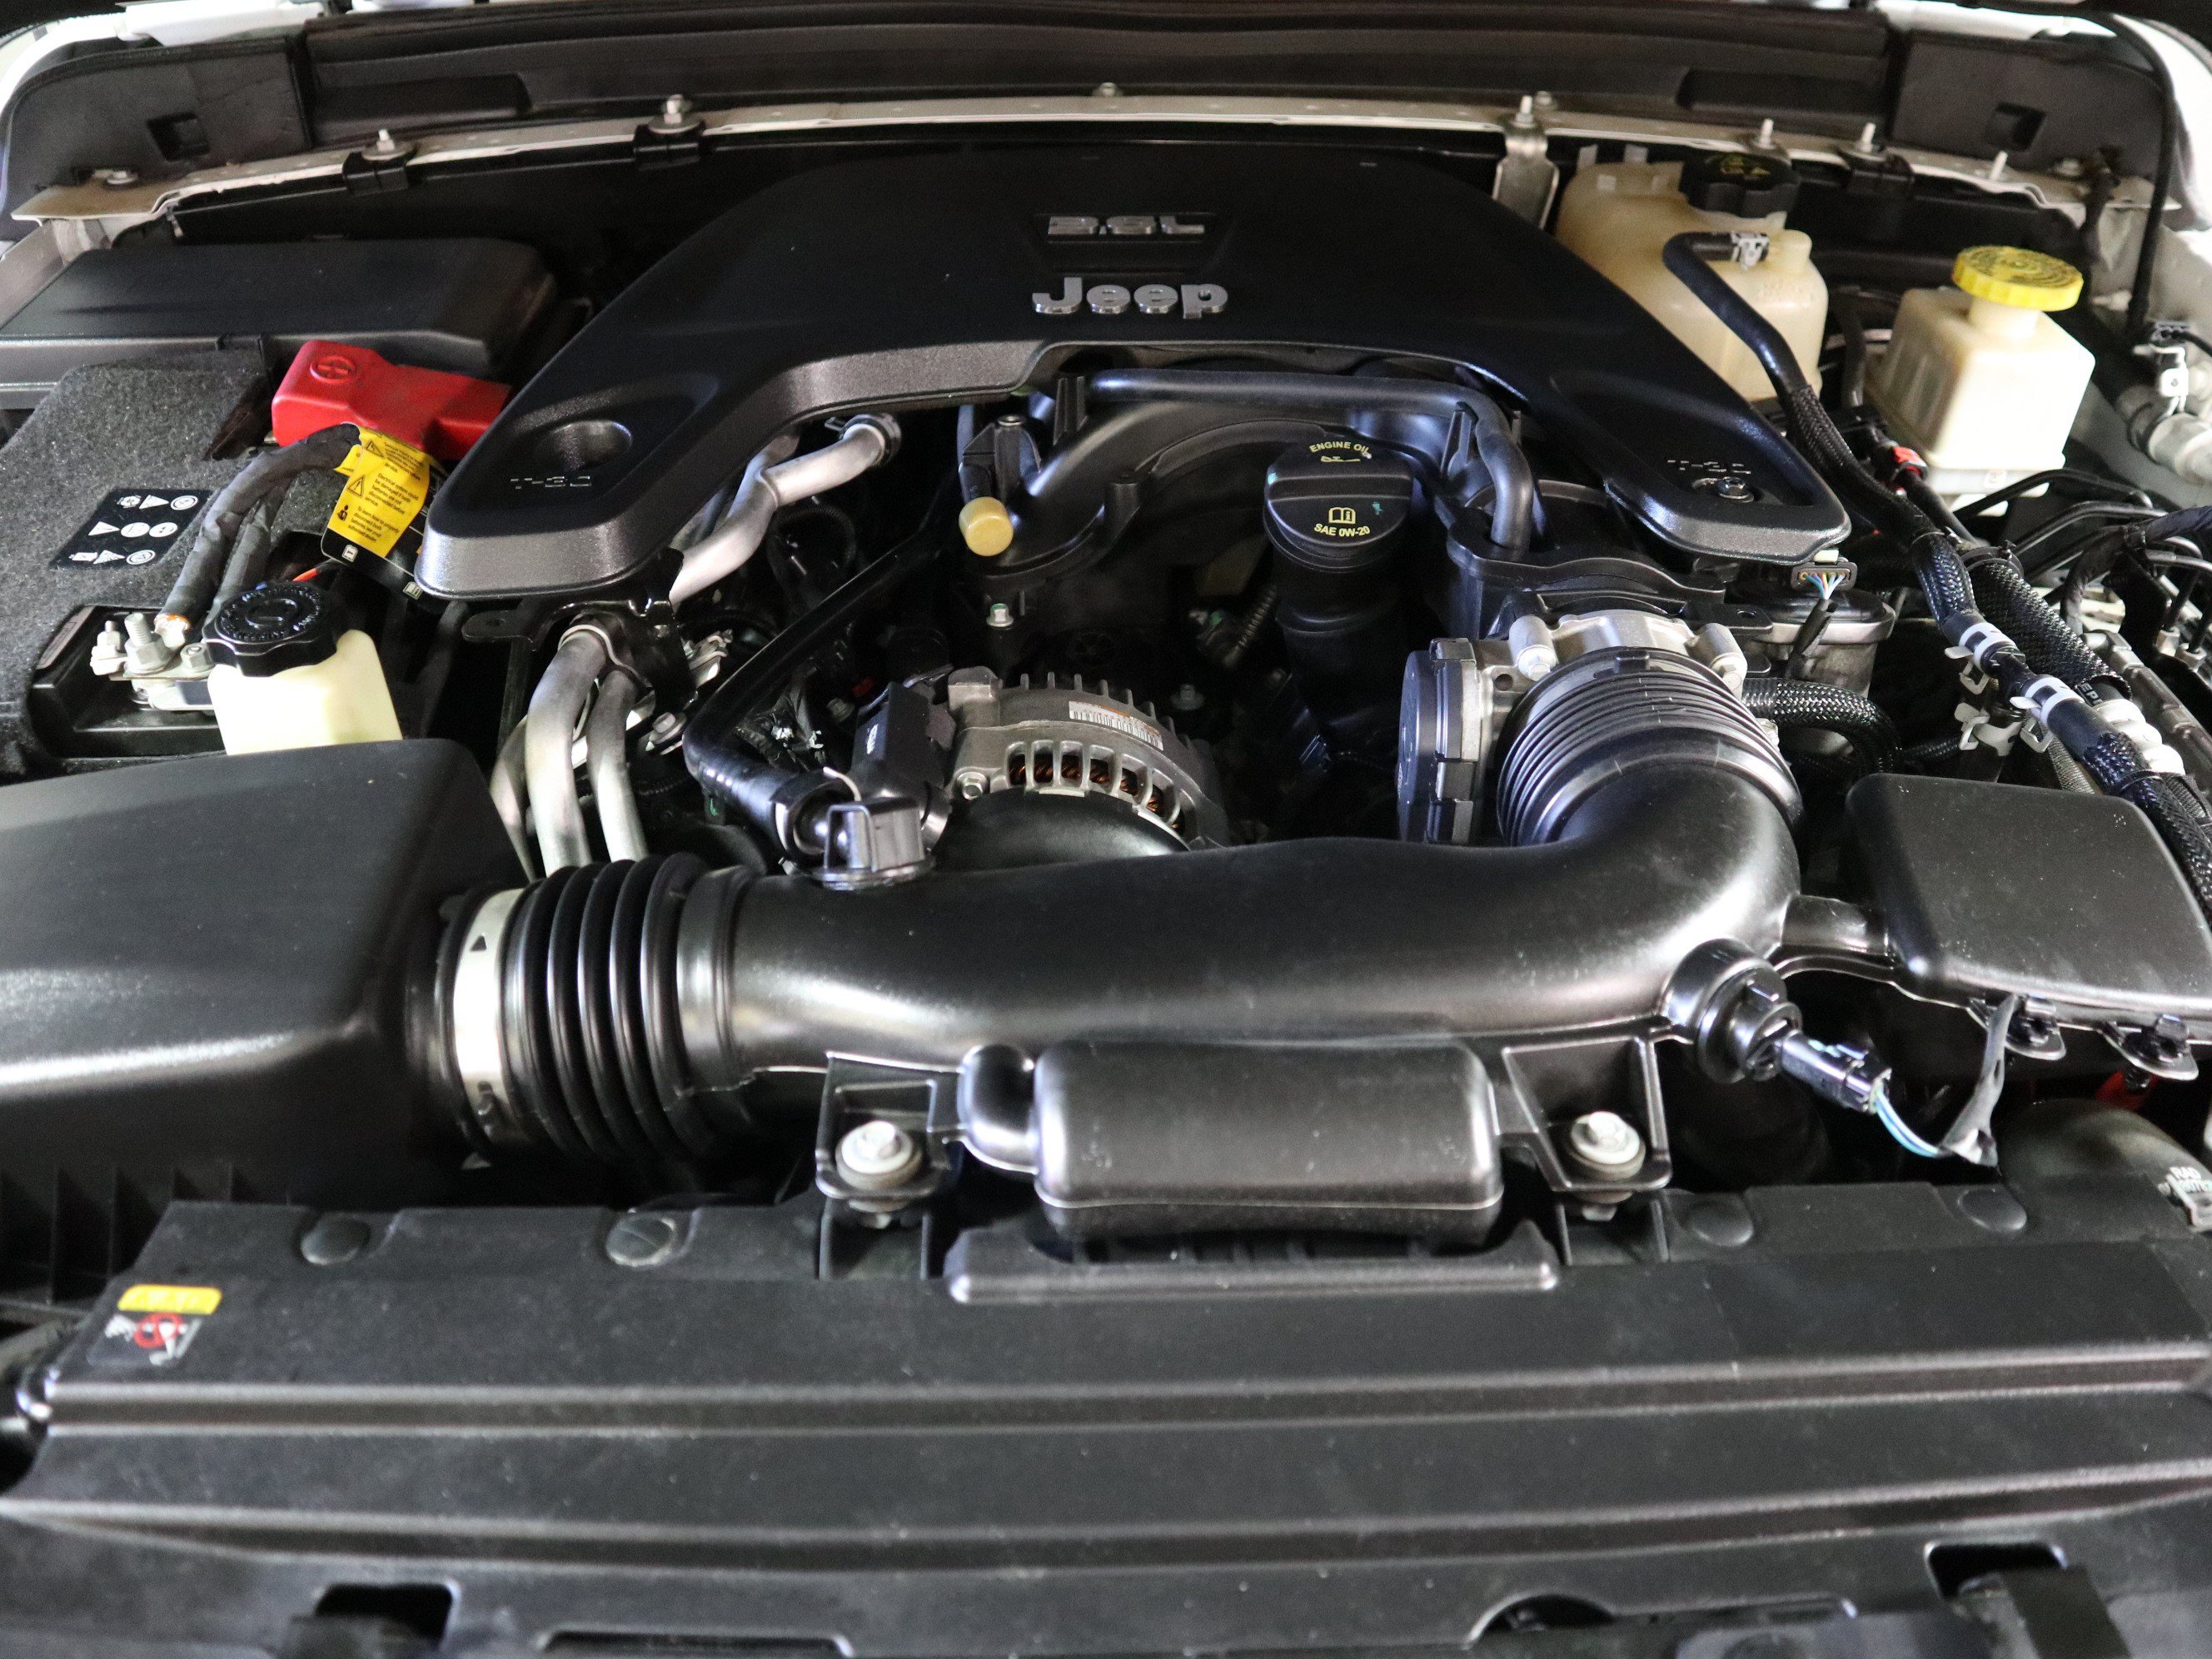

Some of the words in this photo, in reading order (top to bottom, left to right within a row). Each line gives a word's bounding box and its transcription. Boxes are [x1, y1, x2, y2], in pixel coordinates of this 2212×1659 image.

[1032, 276, 1228, 319] Jeep
[1308, 441, 1352, 453] ENGINE
[1353, 443, 1373, 456] OIL
[1313, 523, 1336, 536] SAE
[1338, 525, 1371, 537] 0W-20
